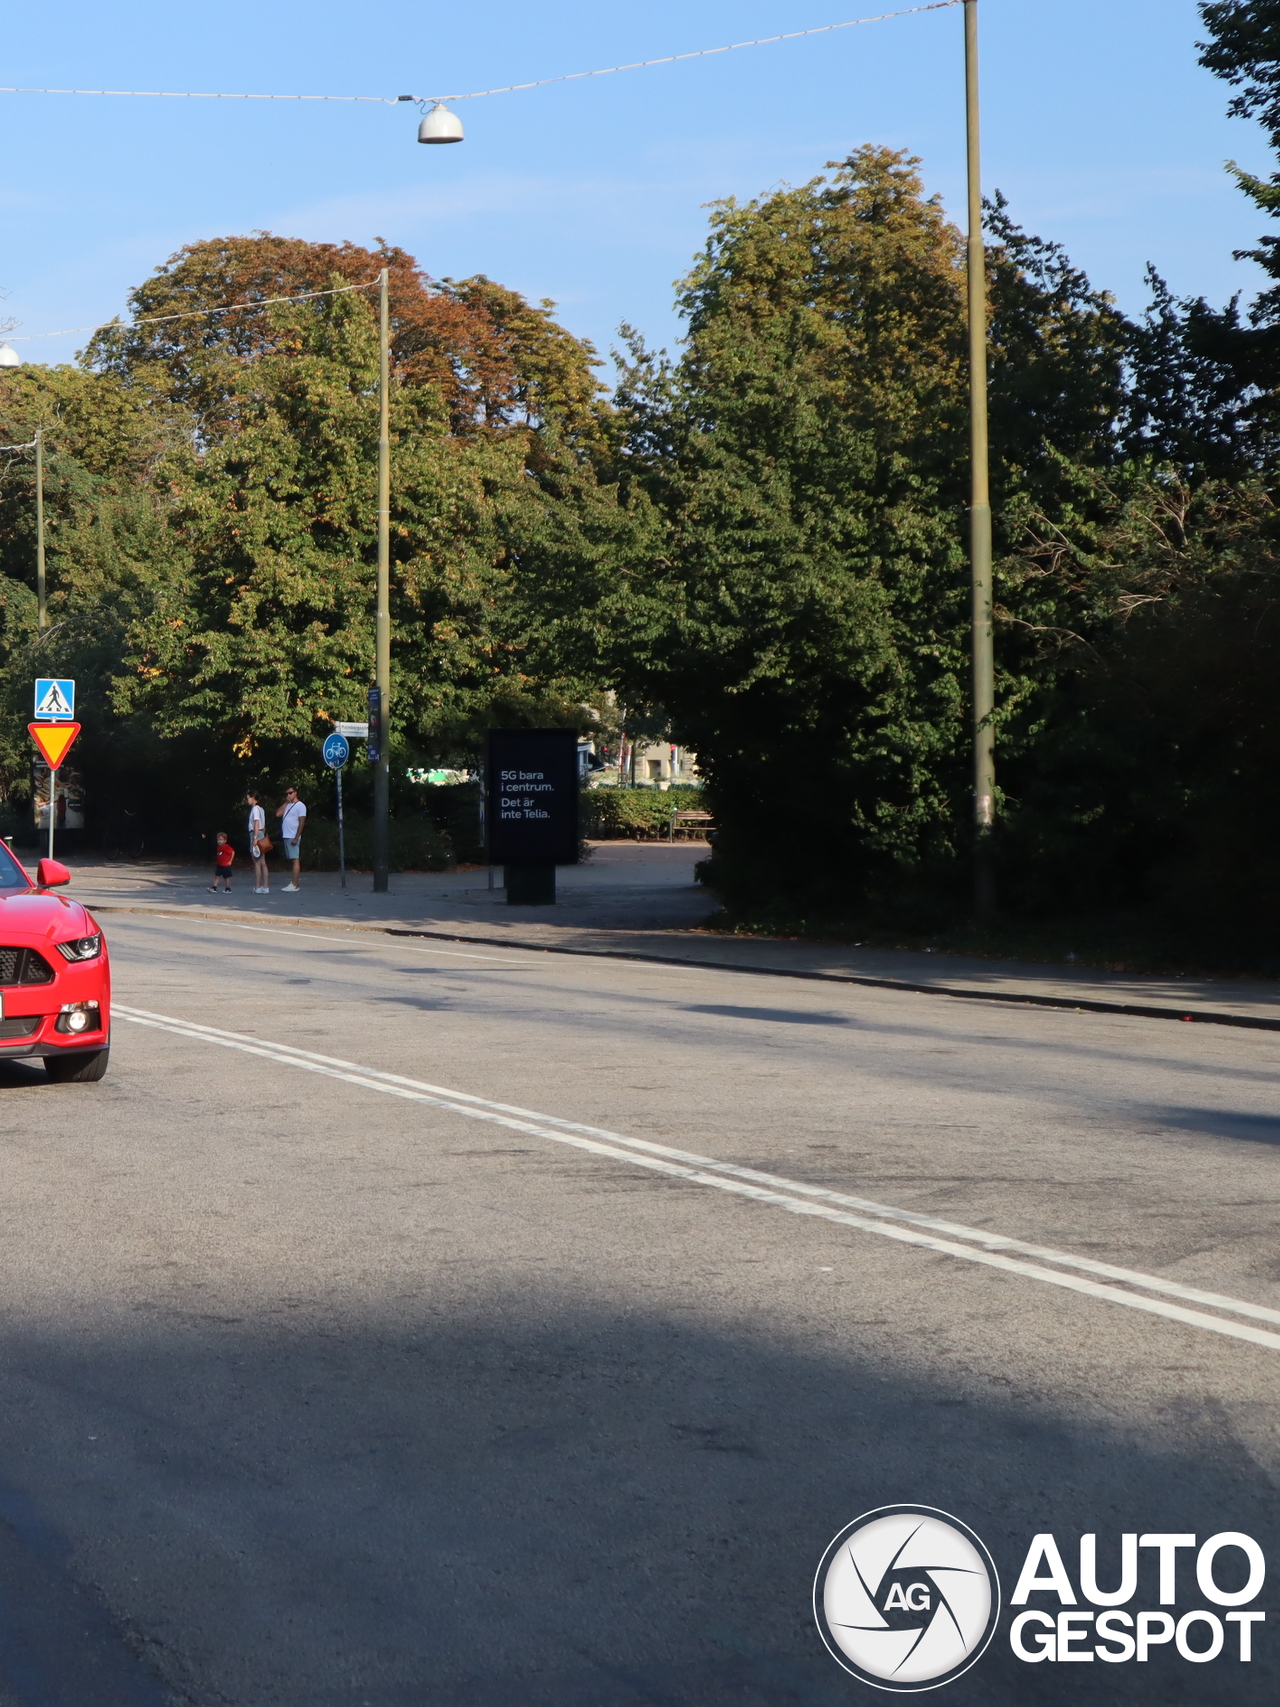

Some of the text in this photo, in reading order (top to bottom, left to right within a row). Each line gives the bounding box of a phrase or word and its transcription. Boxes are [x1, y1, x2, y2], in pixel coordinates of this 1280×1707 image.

[501, 770, 544, 780] 5G bara
[501, 782, 555, 792] i centrum.
[501, 797, 535, 807] Det är
[501, 809, 551, 819] inte Telia.
